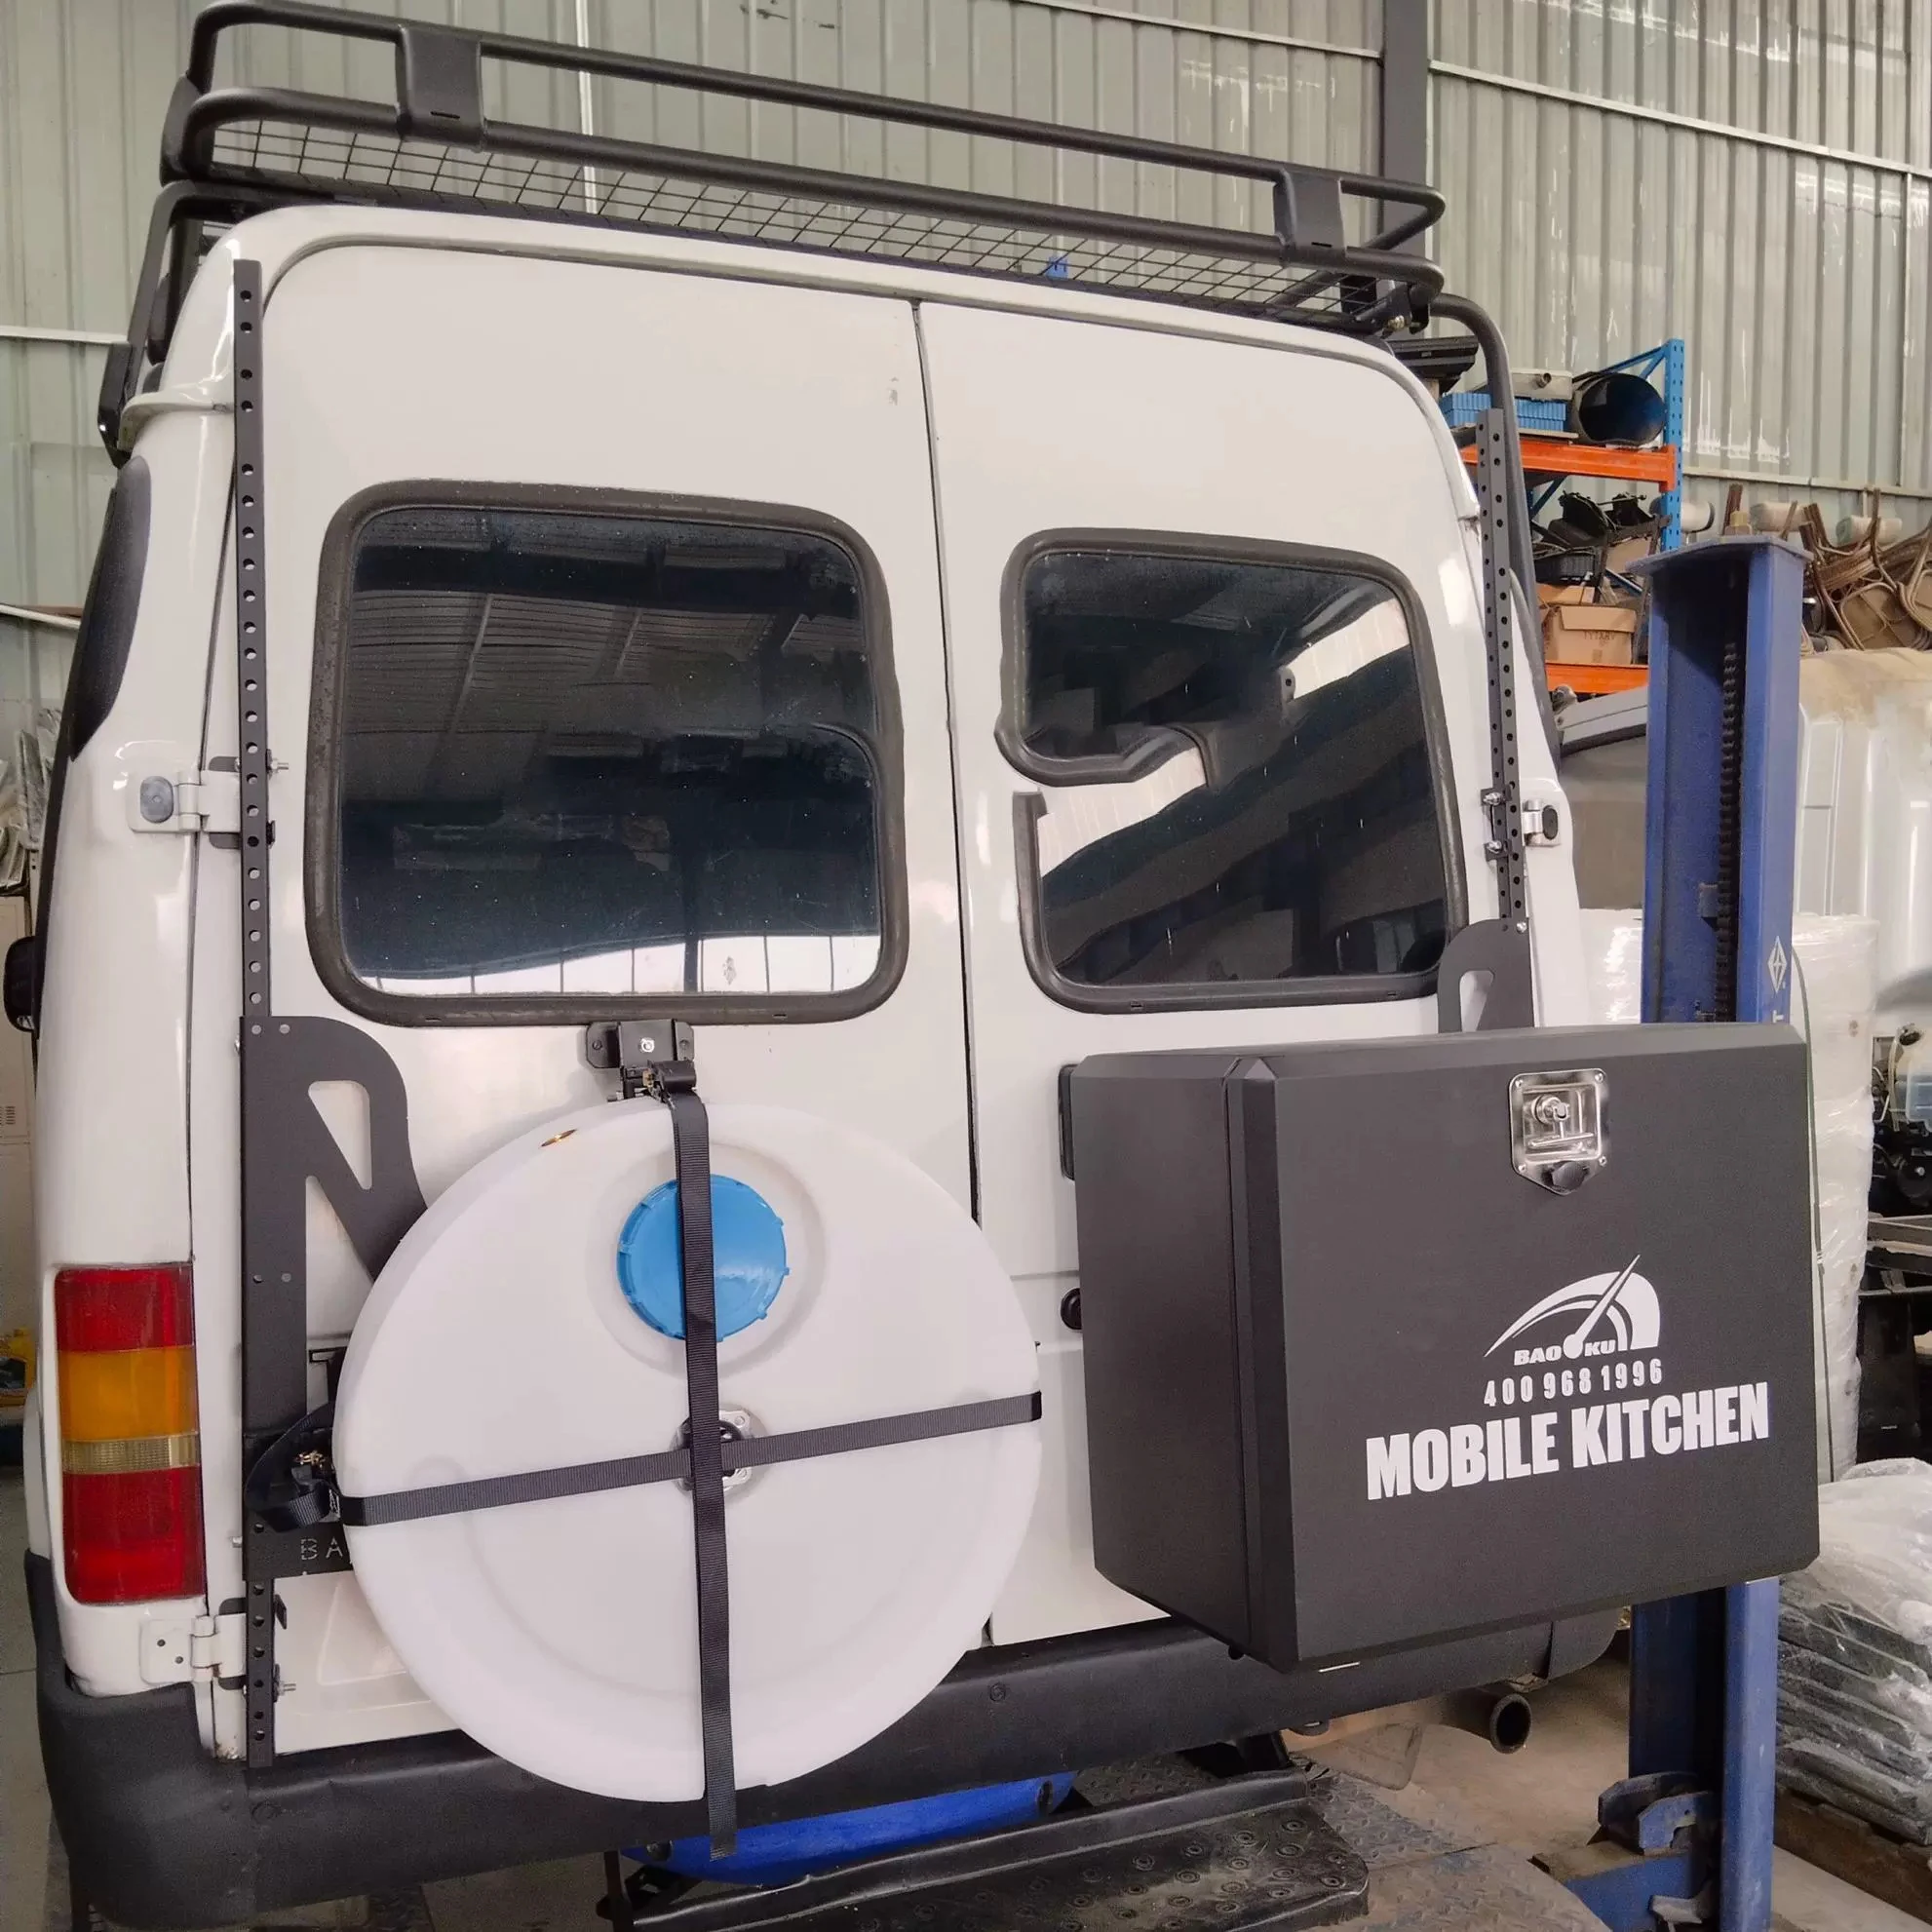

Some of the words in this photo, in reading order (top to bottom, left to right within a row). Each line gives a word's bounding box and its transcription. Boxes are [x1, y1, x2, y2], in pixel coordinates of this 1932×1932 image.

[1484, 1375, 1534, 1407] 400
[1543, 1368, 1592, 1400] 968
[1601, 1358, 1663, 1391] 1996
[1366, 1411, 1560, 1501] MOBILE
[1570, 1382, 1770, 1470] KITCHEN
